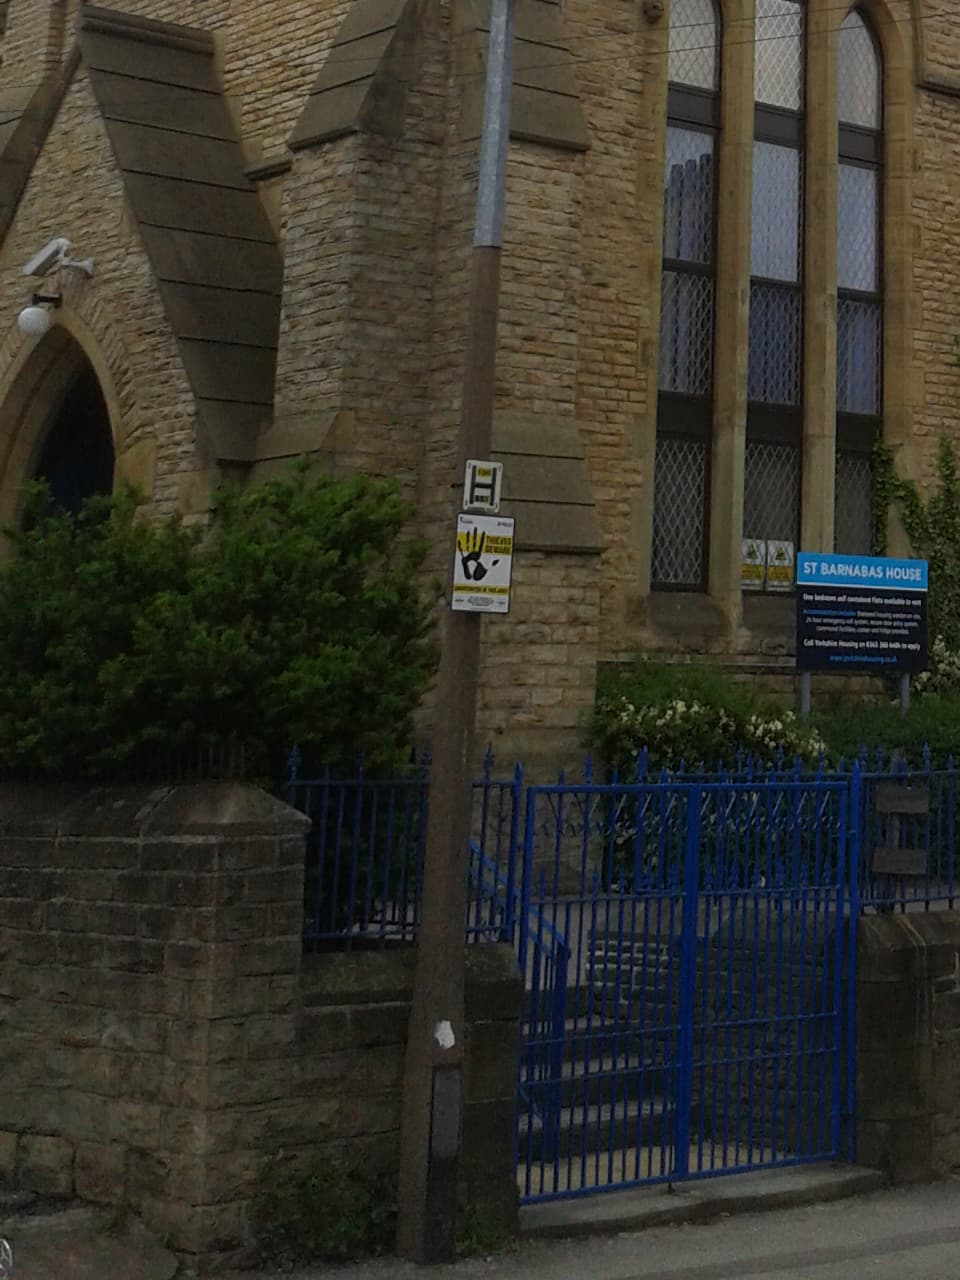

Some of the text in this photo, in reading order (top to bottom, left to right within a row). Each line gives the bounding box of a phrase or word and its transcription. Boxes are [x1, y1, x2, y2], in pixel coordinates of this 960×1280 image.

[803, 561, 818, 575] ST
[820, 562, 884, 578] BARNABAS
[886, 567, 922, 581] HOUSE
